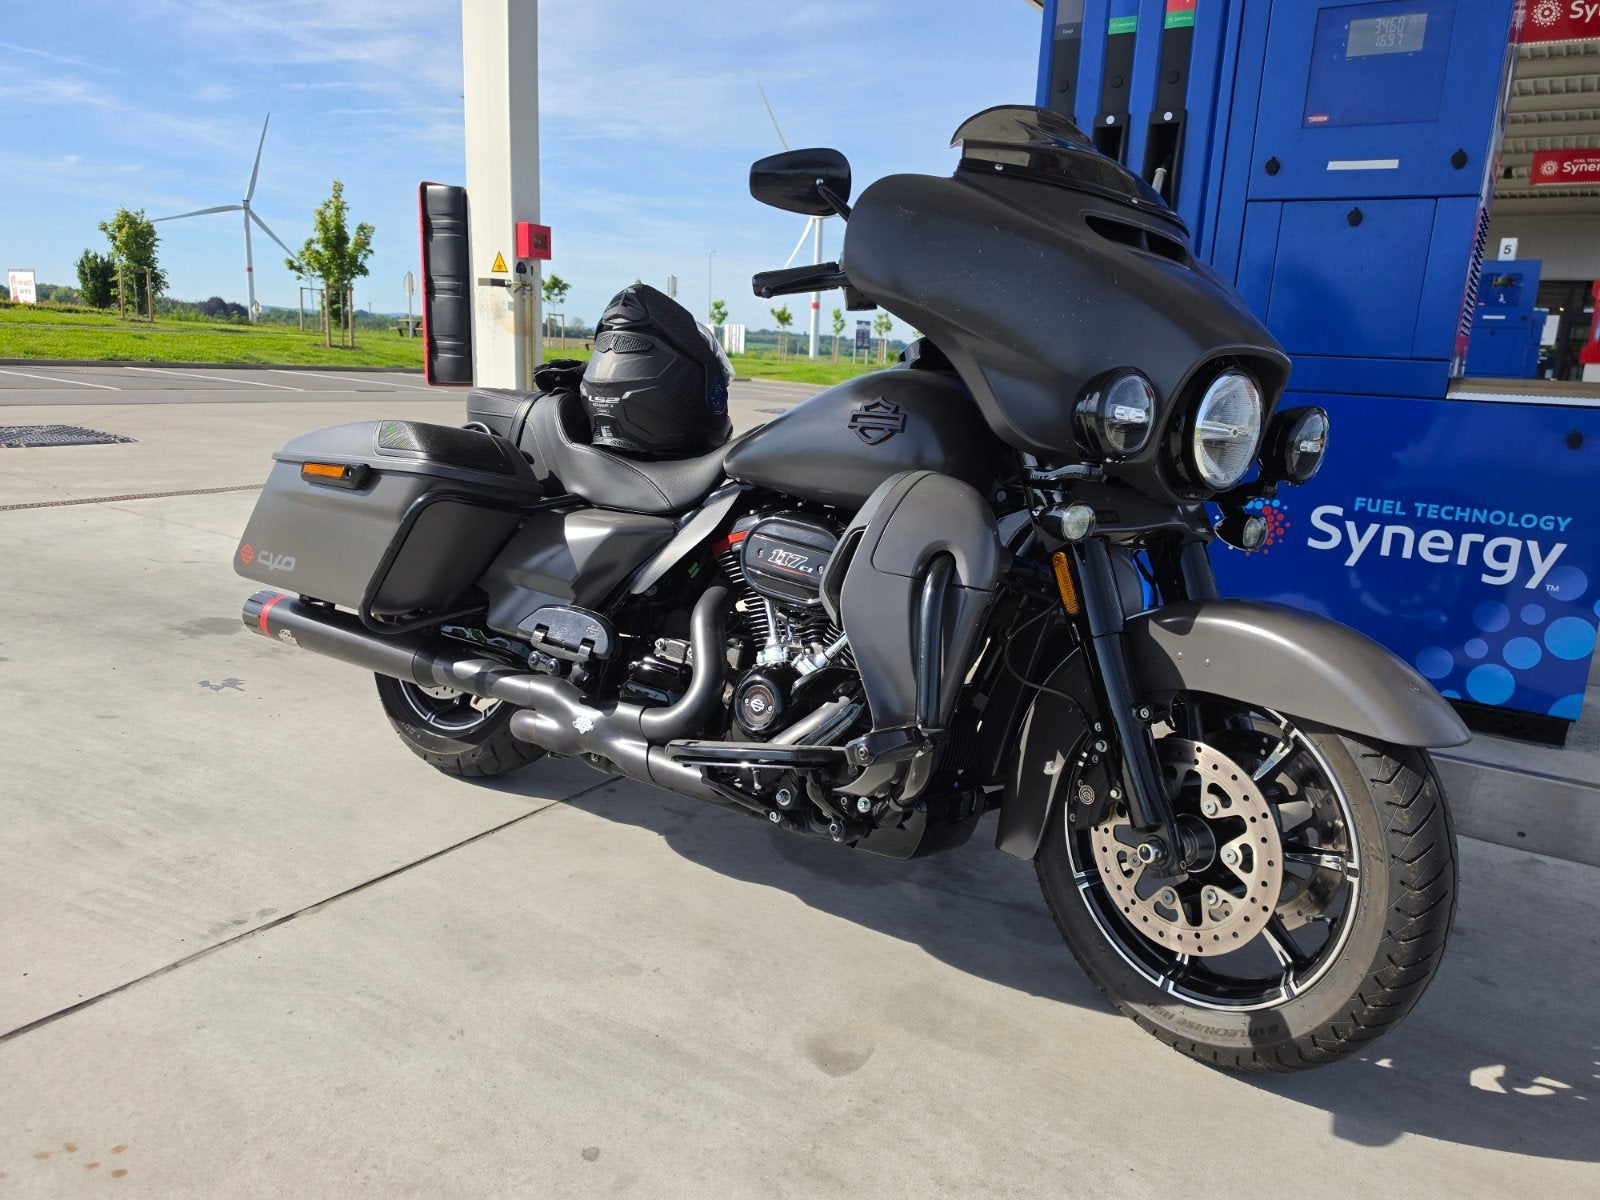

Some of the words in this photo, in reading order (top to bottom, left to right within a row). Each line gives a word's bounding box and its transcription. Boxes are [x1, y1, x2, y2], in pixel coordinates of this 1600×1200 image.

[1569, 0, 1600, 23] Sy
[1503, 244, 1512, 255] 5
[589, 395, 620, 404] LS2
[1354, 497, 1407, 516] FUEL
[1415, 503, 1572, 531] TECHNOLOGY
[1308, 505, 1567, 589] Synergy
[257, 550, 296, 572] CVO
[767, 548, 809, 569] 117
